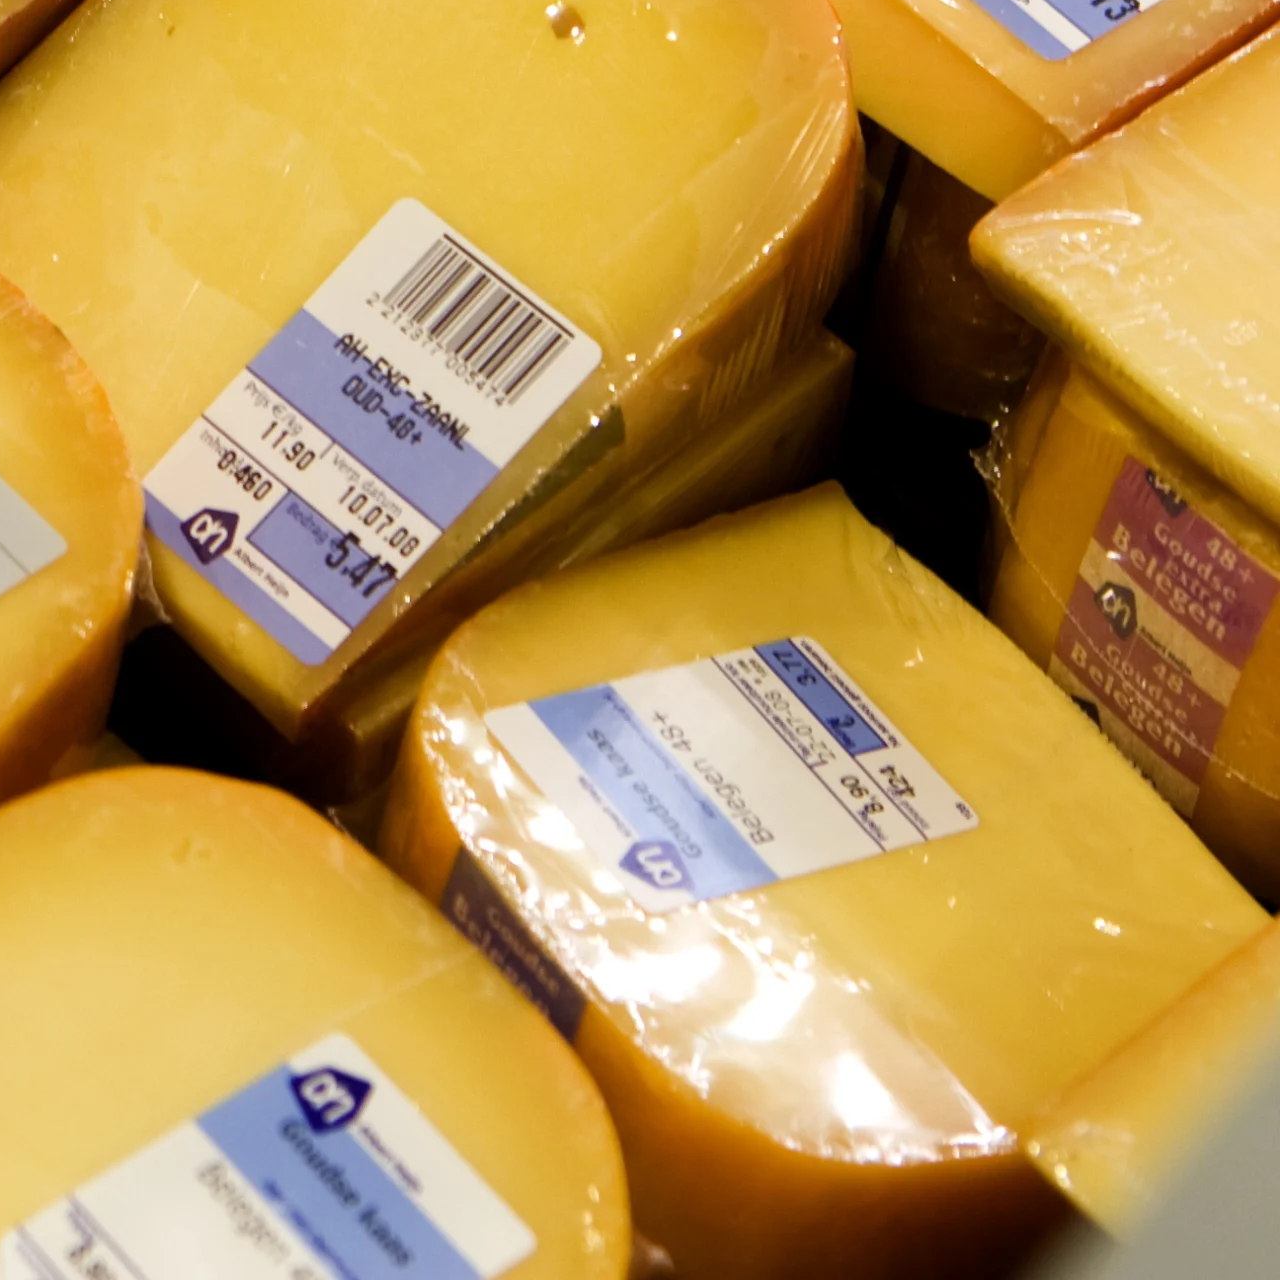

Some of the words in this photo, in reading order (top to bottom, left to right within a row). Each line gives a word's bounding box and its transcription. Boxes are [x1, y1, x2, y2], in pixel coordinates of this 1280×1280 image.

[242, 379, 272, 409] Prijs
[331, 330, 473, 452] AH-EXC-ZAANL
[339, 372, 426, 448] OUD-48+
[258, 418, 317, 473] 11.90
[336, 483, 421, 560] 10.07.08
[360, 477, 405, 521] datum
[232, 545, 264, 576] Albert
[261, 569, 291, 600] Heijn
[322, 528, 399, 602] 5.47
[1111, 521, 1227, 643] Belegen
[1152, 519, 1239, 605] Goudse
[649, 709, 695, 753] 48+
[1069, 638, 1184, 759] Belegen
[582, 727, 633, 778] kaas
[627, 779, 705, 859] Goudse
[689, 756, 777, 844] Belegen
[273, 1118, 365, 1208] Goudse
[353, 1204, 419, 1266] kaas
